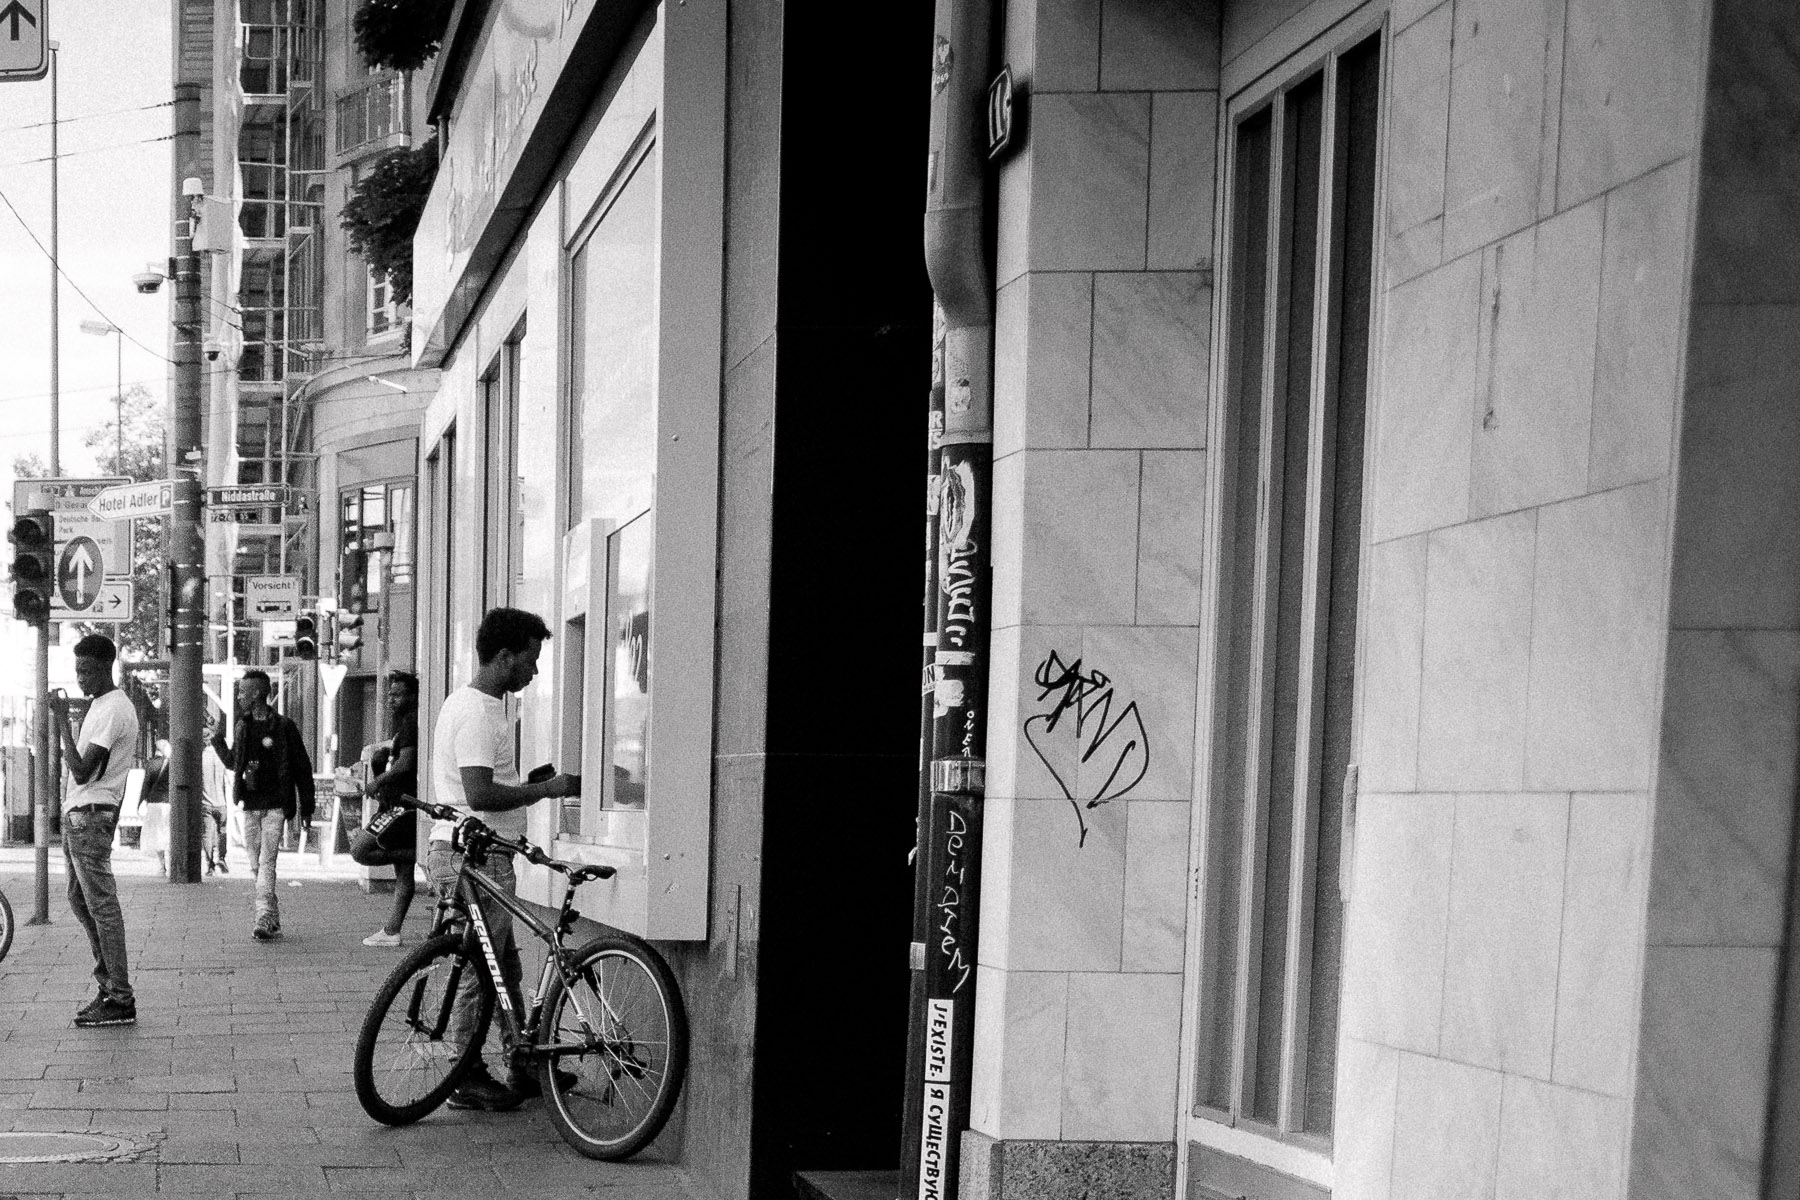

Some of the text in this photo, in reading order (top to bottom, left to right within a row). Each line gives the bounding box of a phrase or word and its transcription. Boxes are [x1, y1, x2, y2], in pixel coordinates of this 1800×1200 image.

[99, 495, 126, 511] Hotel
[130, 492, 158, 509] Adler
[221, 489, 276, 502] Niddastraße
[929, 1087, 944, 1100] Я
